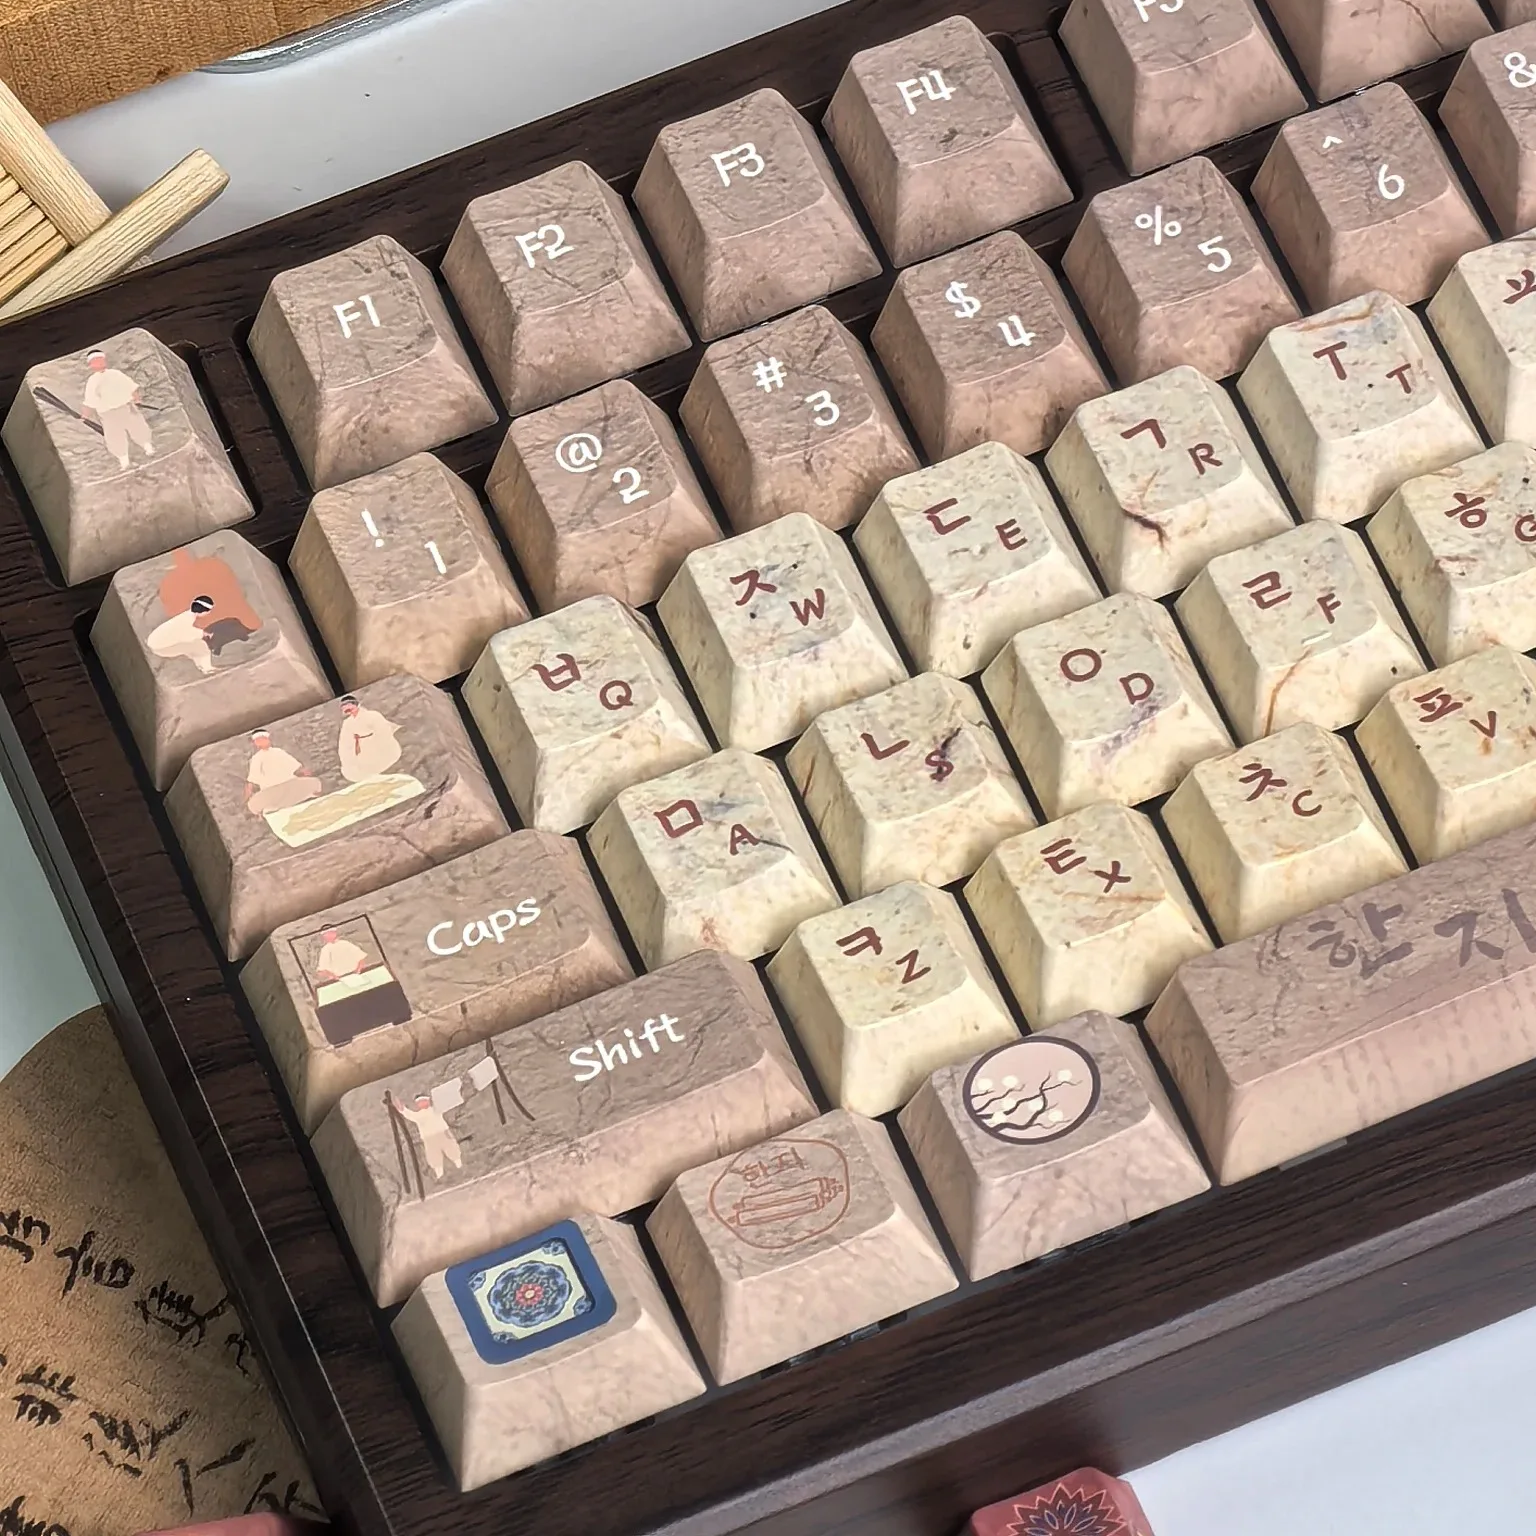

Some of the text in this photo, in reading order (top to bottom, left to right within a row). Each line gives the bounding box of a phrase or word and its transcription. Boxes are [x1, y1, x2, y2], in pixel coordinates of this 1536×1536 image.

[895, 69, 957, 115] F4
[710, 142, 765, 187] F3
[1377, 163, 1405, 200] 6
[514, 224, 575, 269] F2
[1134, 205, 1232, 273] % 5
[332, 294, 381, 339] F1
[945, 281, 1036, 347] $ 4
[751, 356, 840, 427] # 3
[1385, 363, 1412, 395] T
[555, 432, 650, 504] @ 2
[1187, 443, 1223, 475] R
[361, 508, 385, 548] !
[995, 518, 1028, 551] E
[788, 588, 826, 627] W
[1316, 592, 1342, 625] F
[599, 679, 634, 711] Q
[1119, 672, 1155, 705] D
[1468, 710, 1497, 739] V
[924, 745, 954, 783] S
[1292, 789, 1323, 817] C
[729, 823, 765, 856] A
[1092, 860, 1132, 894] X
[426, 897, 541, 955] Caps
[895, 949, 932, 985] Z
[569, 1013, 685, 1082] Shift
